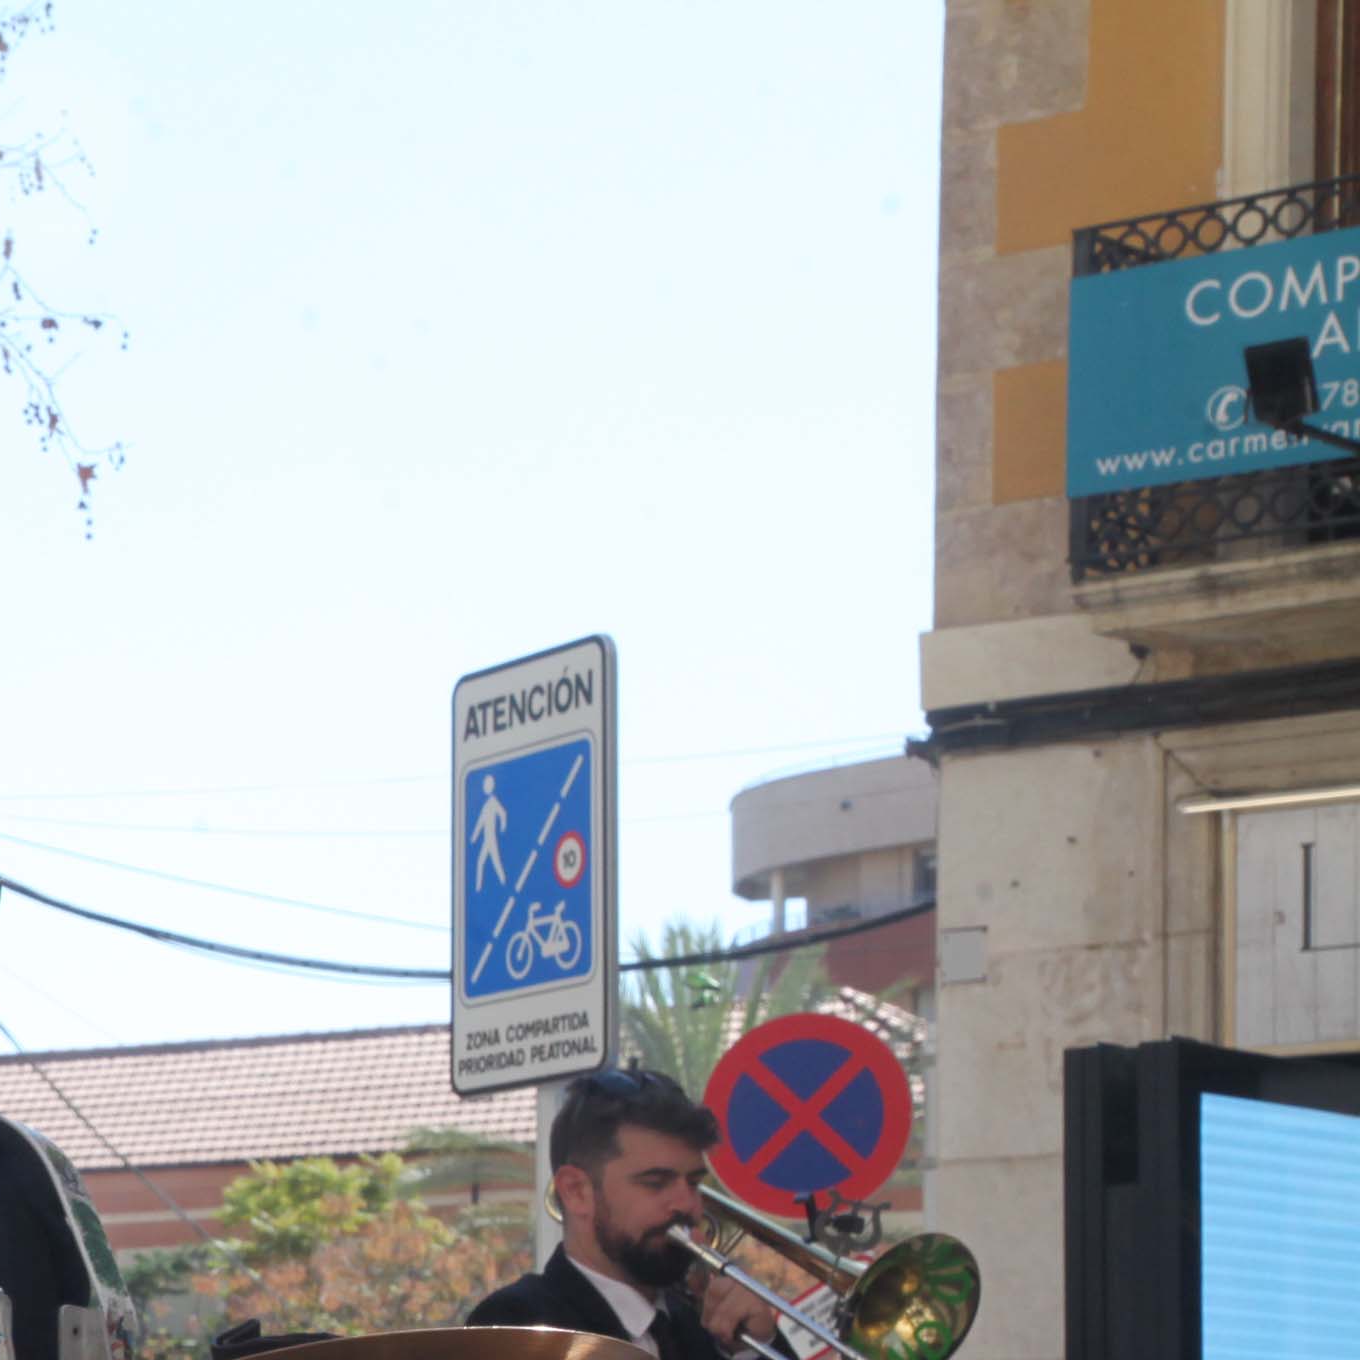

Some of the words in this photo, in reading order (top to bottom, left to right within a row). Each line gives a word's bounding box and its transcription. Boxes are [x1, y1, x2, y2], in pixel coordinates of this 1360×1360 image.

[1185, 255, 1360, 326] COMP
[463, 668, 594, 742] ATENCIÓN
[562, 849, 577, 868] 10
[465, 1026, 502, 1051] ZONA
[506, 1010, 591, 1043] COMPARTIDA
[458, 1047, 526, 1077] PRIORIDAD
[530, 1036, 599, 1064] PEATONAL
